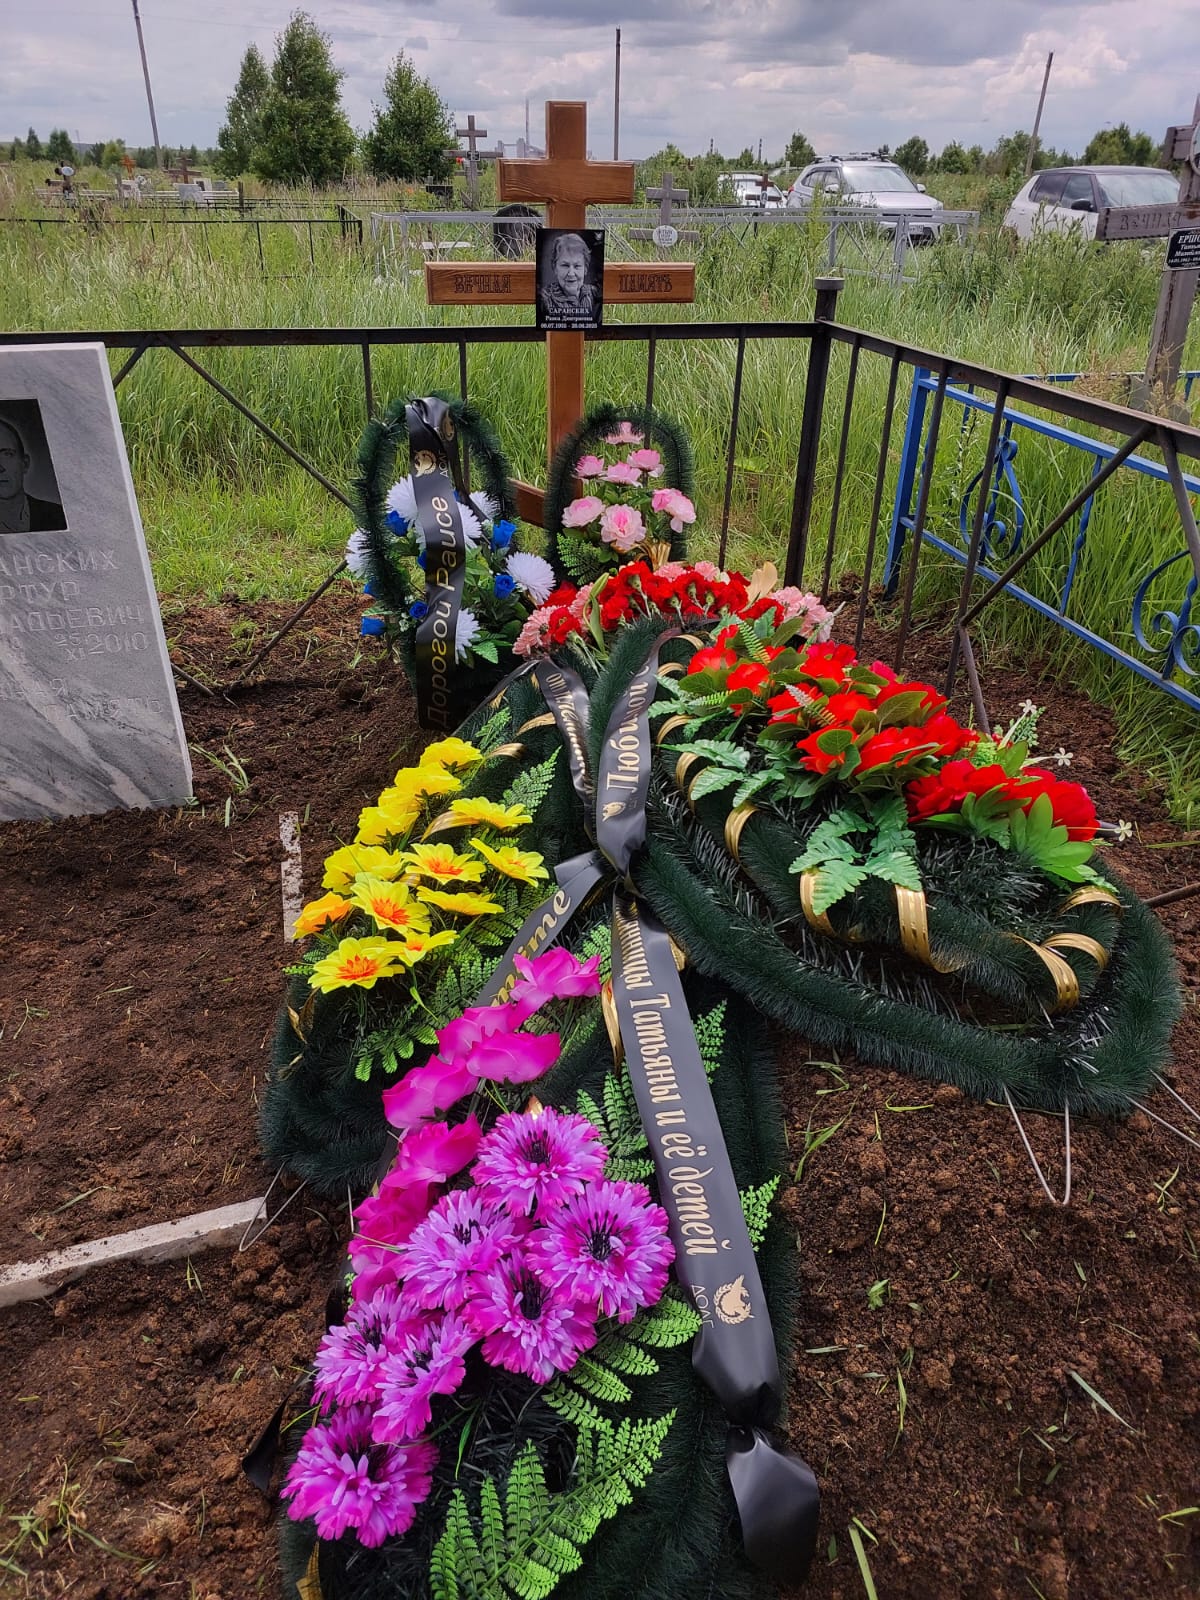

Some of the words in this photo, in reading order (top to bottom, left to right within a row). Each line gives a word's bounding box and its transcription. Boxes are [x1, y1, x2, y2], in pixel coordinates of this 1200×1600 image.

[454, 274, 512, 294] ВЕЧНАЯ
[618, 274, 673, 293] ПАМЯТЬ
[431, 496, 457, 592] Раисе
[86, 632, 148, 655] 2010
[427, 600, 453, 730] Дорогой
[629, 993, 683, 1104] Татьяны
[655, 1109, 687, 1127] и
[660, 1132, 708, 1160] её
[668, 1165, 733, 1256] детей
